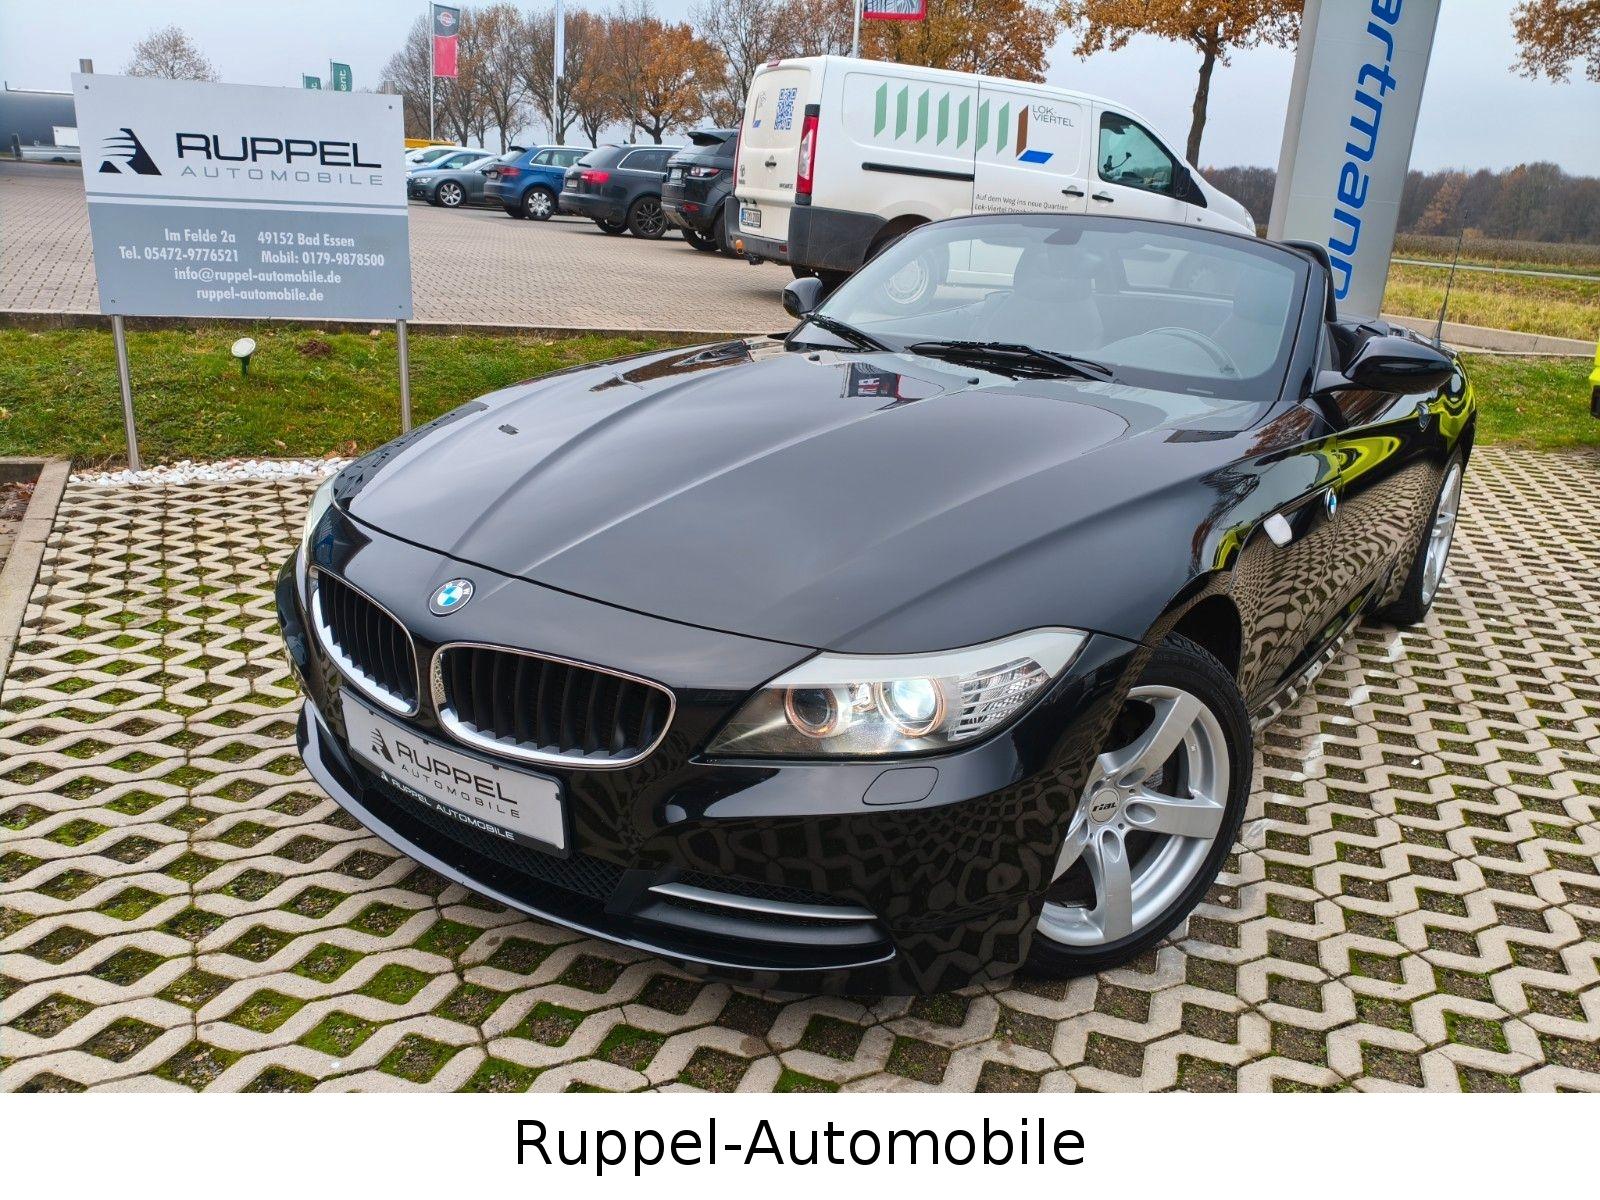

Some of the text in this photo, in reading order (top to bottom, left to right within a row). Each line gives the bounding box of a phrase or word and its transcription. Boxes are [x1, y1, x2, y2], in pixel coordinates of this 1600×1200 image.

[1032, 112, 1074, 127] VIERTEL
[176, 132, 382, 168] RUPPEL
[181, 166, 383, 186] AUTOMOBILE
[1003, 197, 1016, 206] Weg
[1027, 200, 1042, 208] neue
[1043, 201, 1068, 211] Quartier
[164, 228, 355, 247] Im Felde 2a 49152 Bad Essen
[119, 245, 385, 267] Tel. 05472-9776521 Mobil: 0179-9878500
[174, 266, 342, 284] info@ruppel-automobile.de
[196, 286, 325, 302] ruppel-automobile.de
[396, 740, 518, 805] RUPPEL
[402, 764, 521, 819] AUTOMOBILE
[391, 778, 516, 841] RUPPEL AUTOMOBILE
